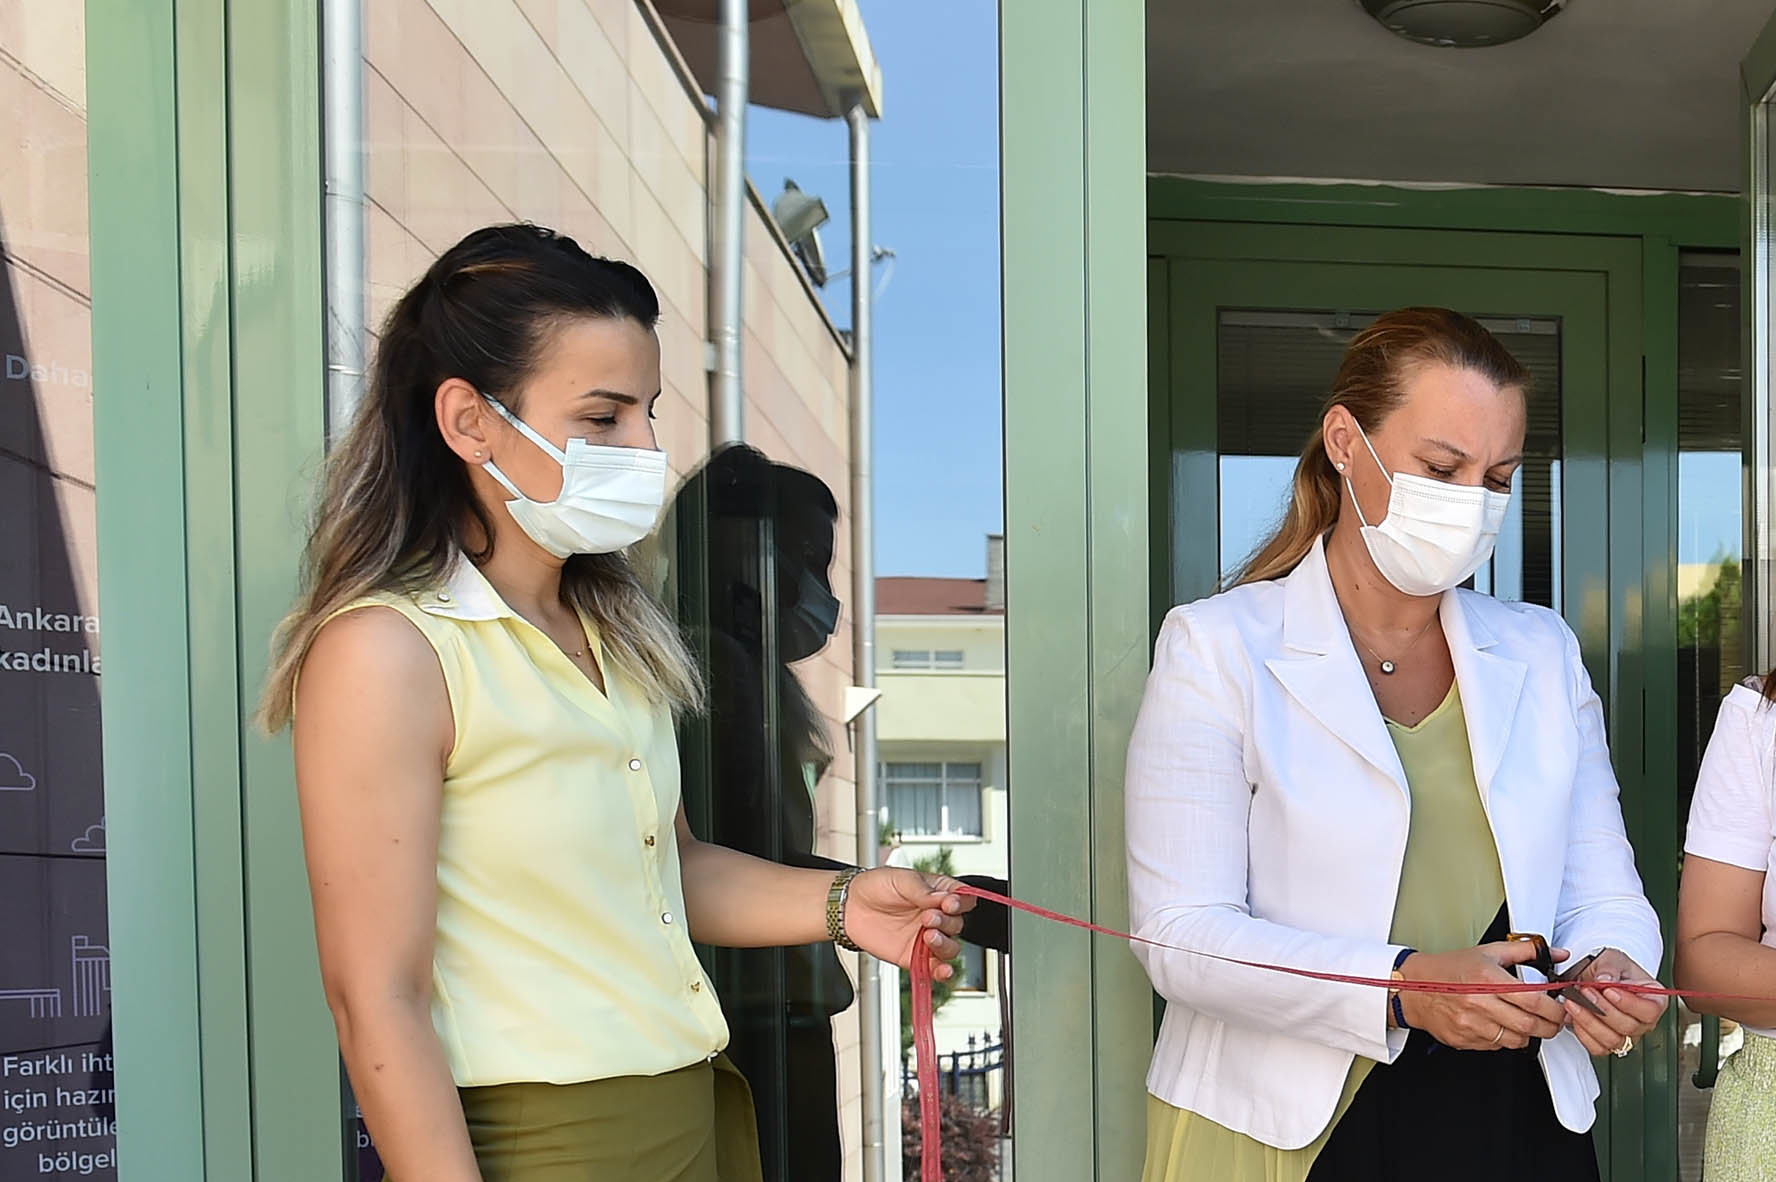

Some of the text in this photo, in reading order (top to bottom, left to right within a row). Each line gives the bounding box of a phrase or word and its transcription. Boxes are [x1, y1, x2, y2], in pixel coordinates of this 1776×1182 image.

[0, 605, 99, 633] Ankara
[3, 1053, 112, 1077] Farklı iht
[4, 1088, 47, 1113] için
[39, 1148, 115, 1175] bölgel
